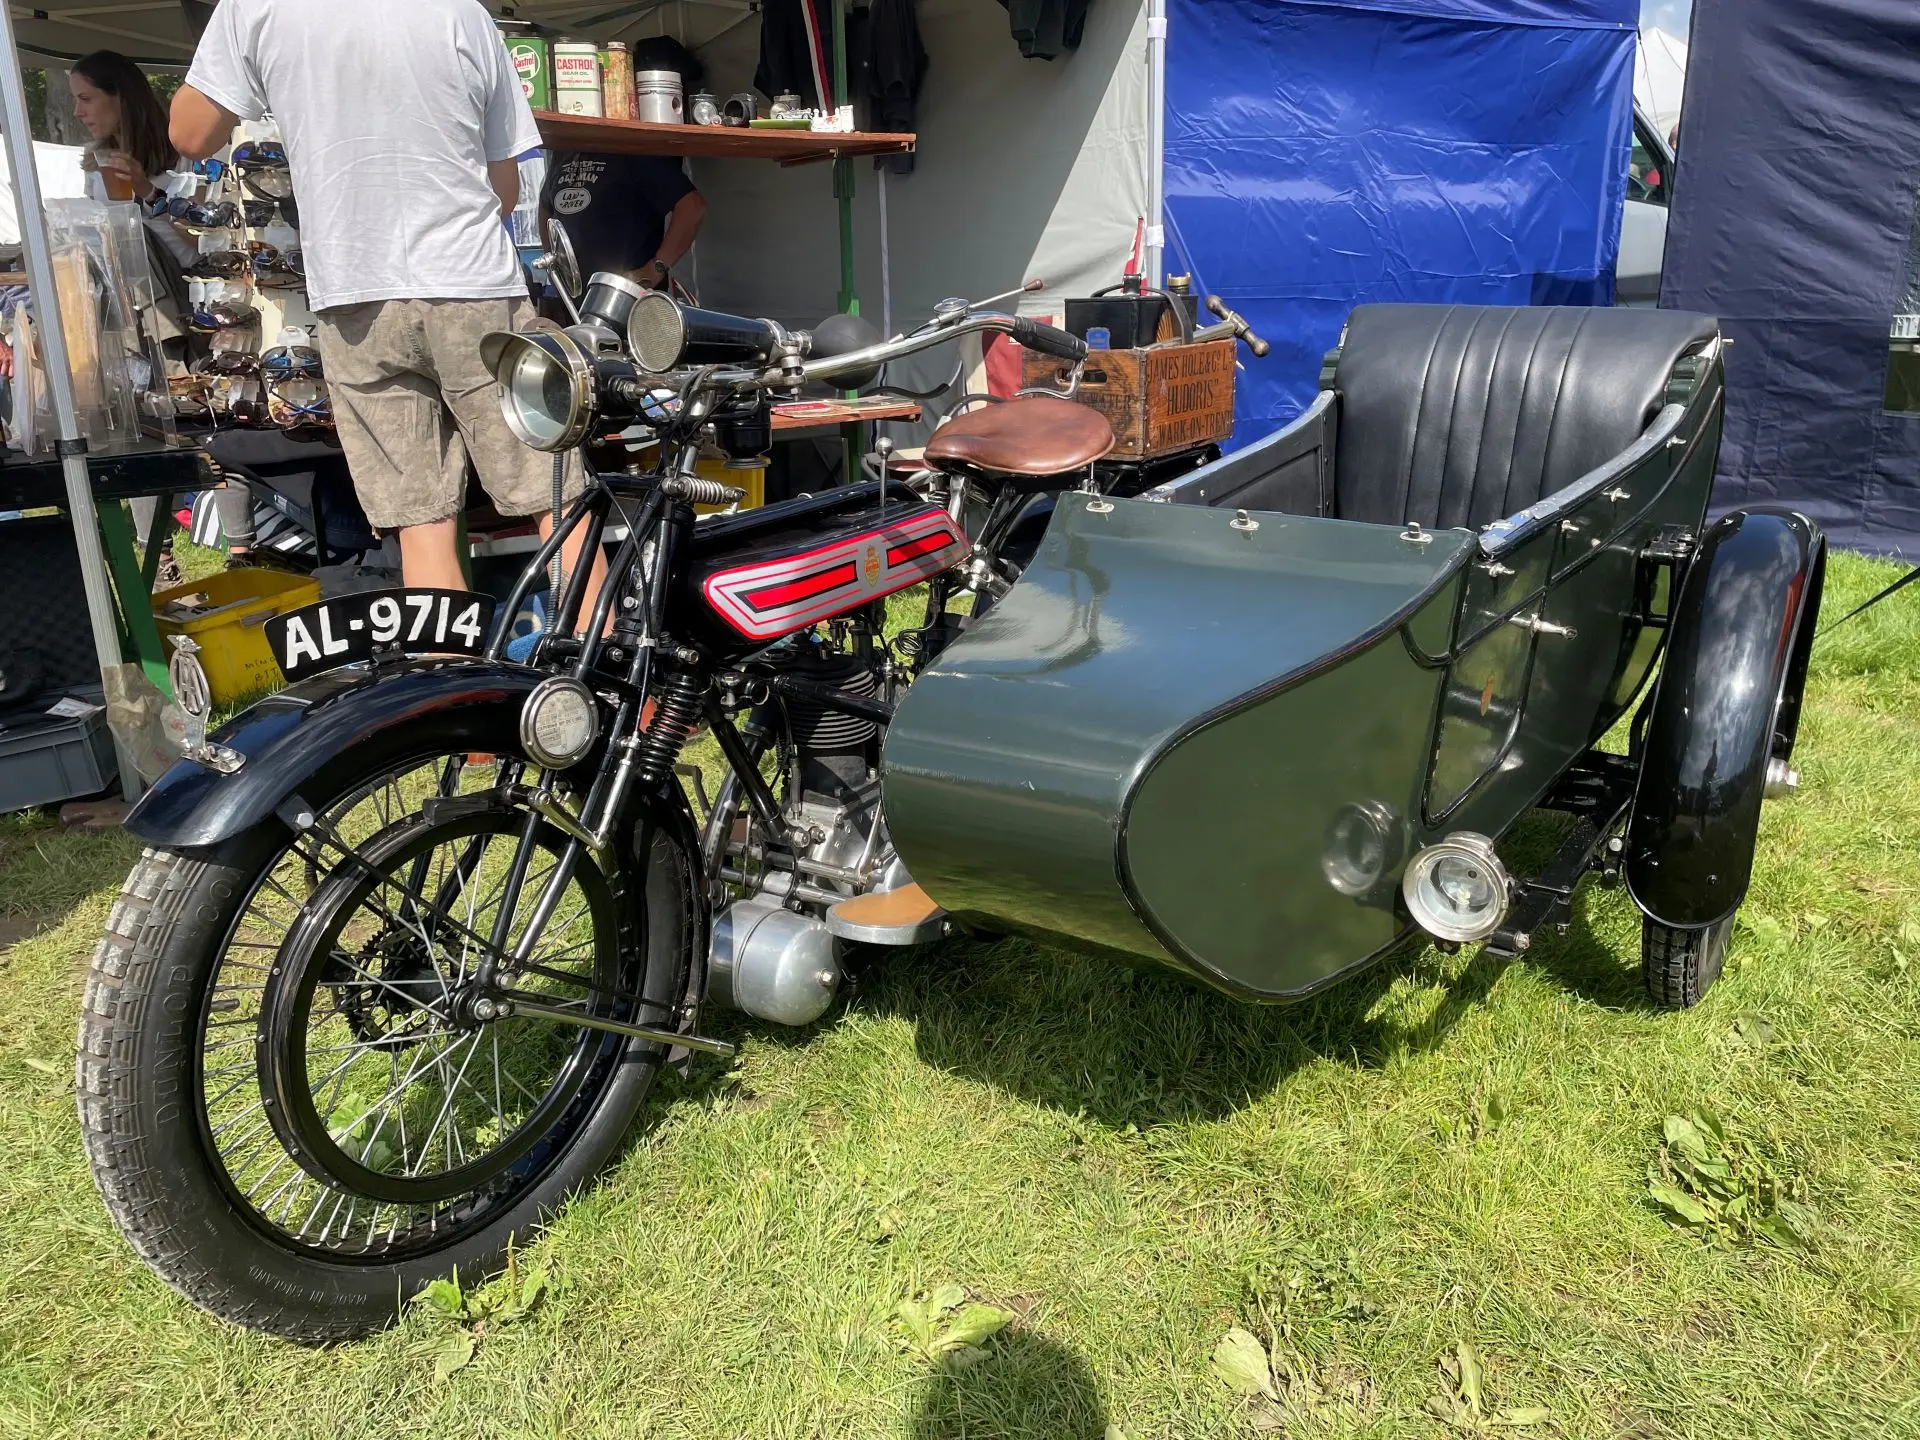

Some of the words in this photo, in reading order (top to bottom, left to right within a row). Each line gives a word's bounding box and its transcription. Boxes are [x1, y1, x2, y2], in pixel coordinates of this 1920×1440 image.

[513, 53, 535, 68] Castrol
[556, 58, 594, 71] CASTROL
[1147, 355, 1180, 383] JAMES
[285, 596, 482, 670] AL-9714
[153, 964, 195, 1129] DUNLOP
[248, 1264, 304, 1298] ENGLAND
[308, 1288, 325, 1304] IN
